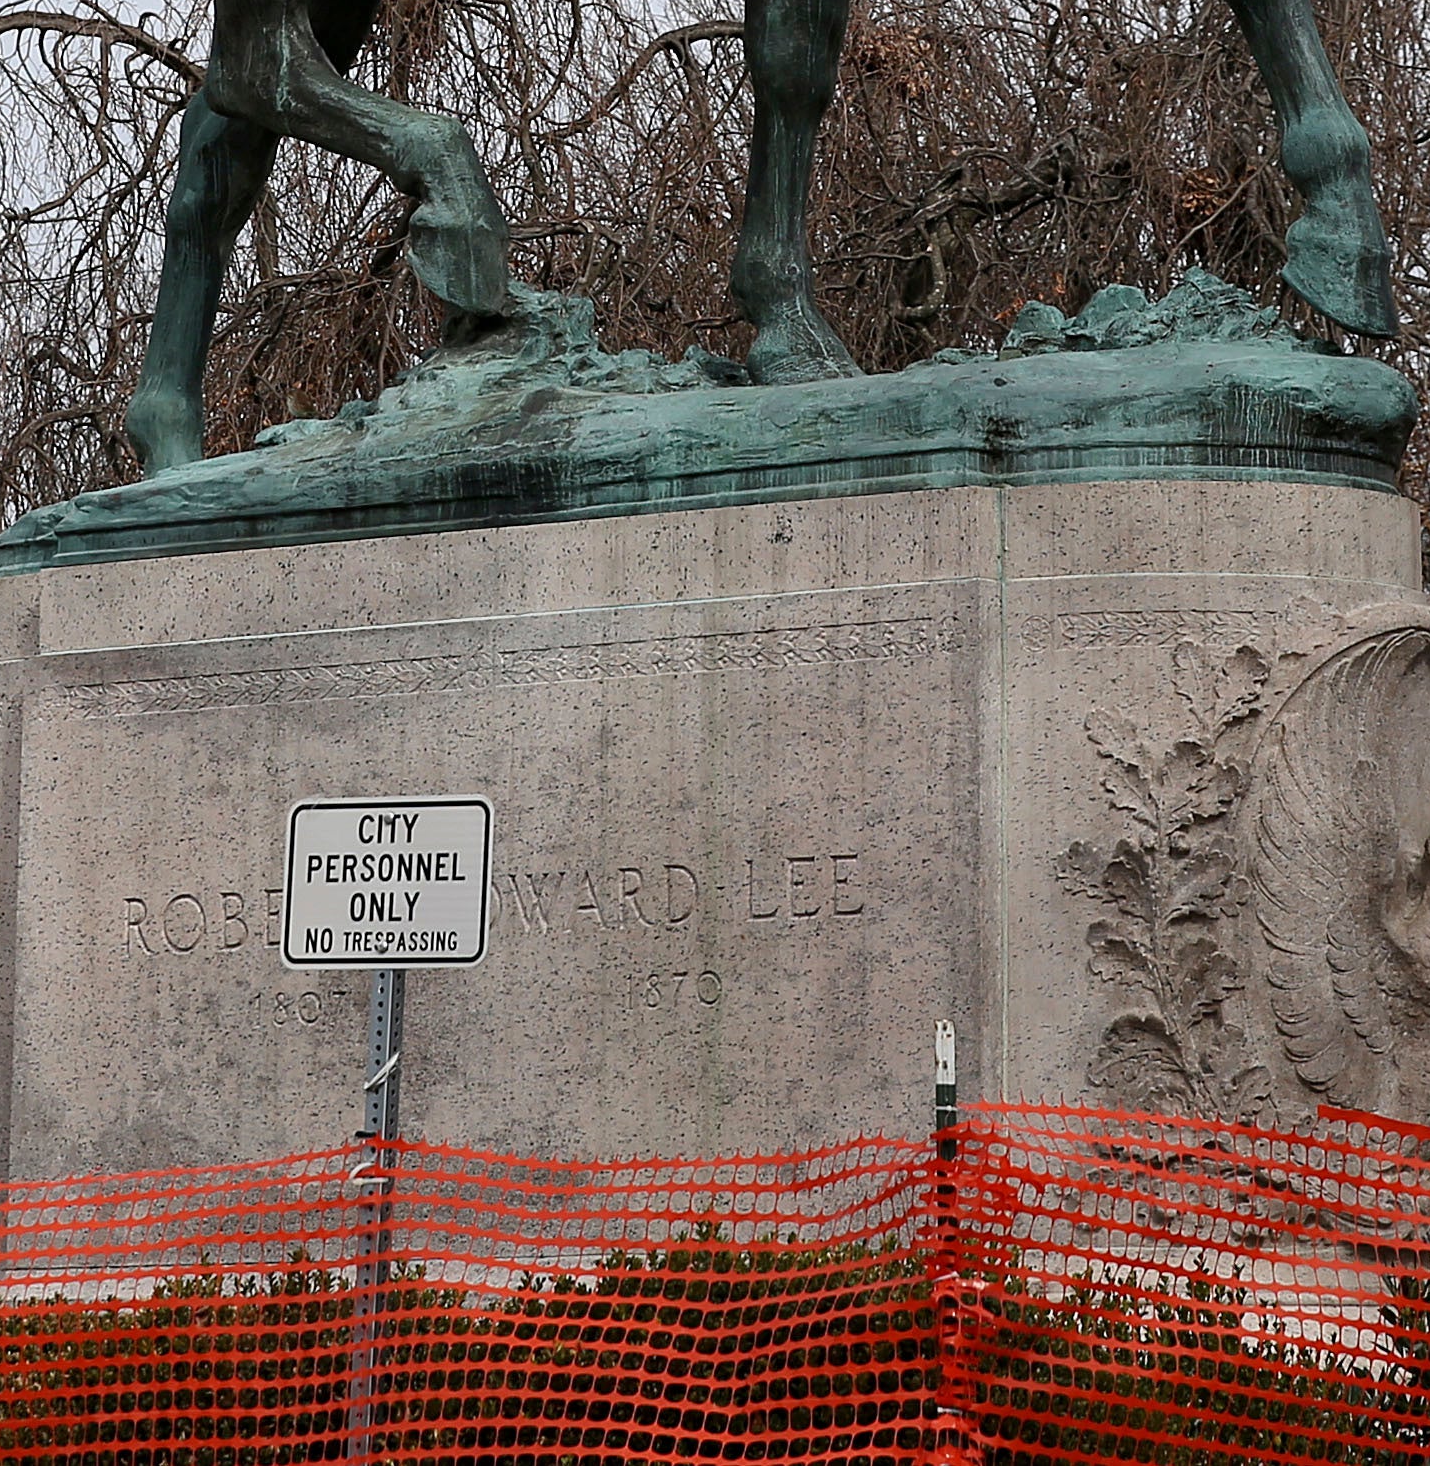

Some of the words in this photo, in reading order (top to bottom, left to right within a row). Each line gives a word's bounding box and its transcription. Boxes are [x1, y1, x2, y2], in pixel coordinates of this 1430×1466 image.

[358, 813, 419, 844] CITY
[306, 852, 466, 883] PERSONNEL
[123, 888, 285, 959] ROBE
[490, 863, 699, 933] WARD
[744, 853, 865, 921] LEE
[349, 891, 420, 922] ONLY
[305, 928, 333, 953] NO
[343, 931, 458, 952] TRESPASSING
[625, 970, 723, 1011] 1870
